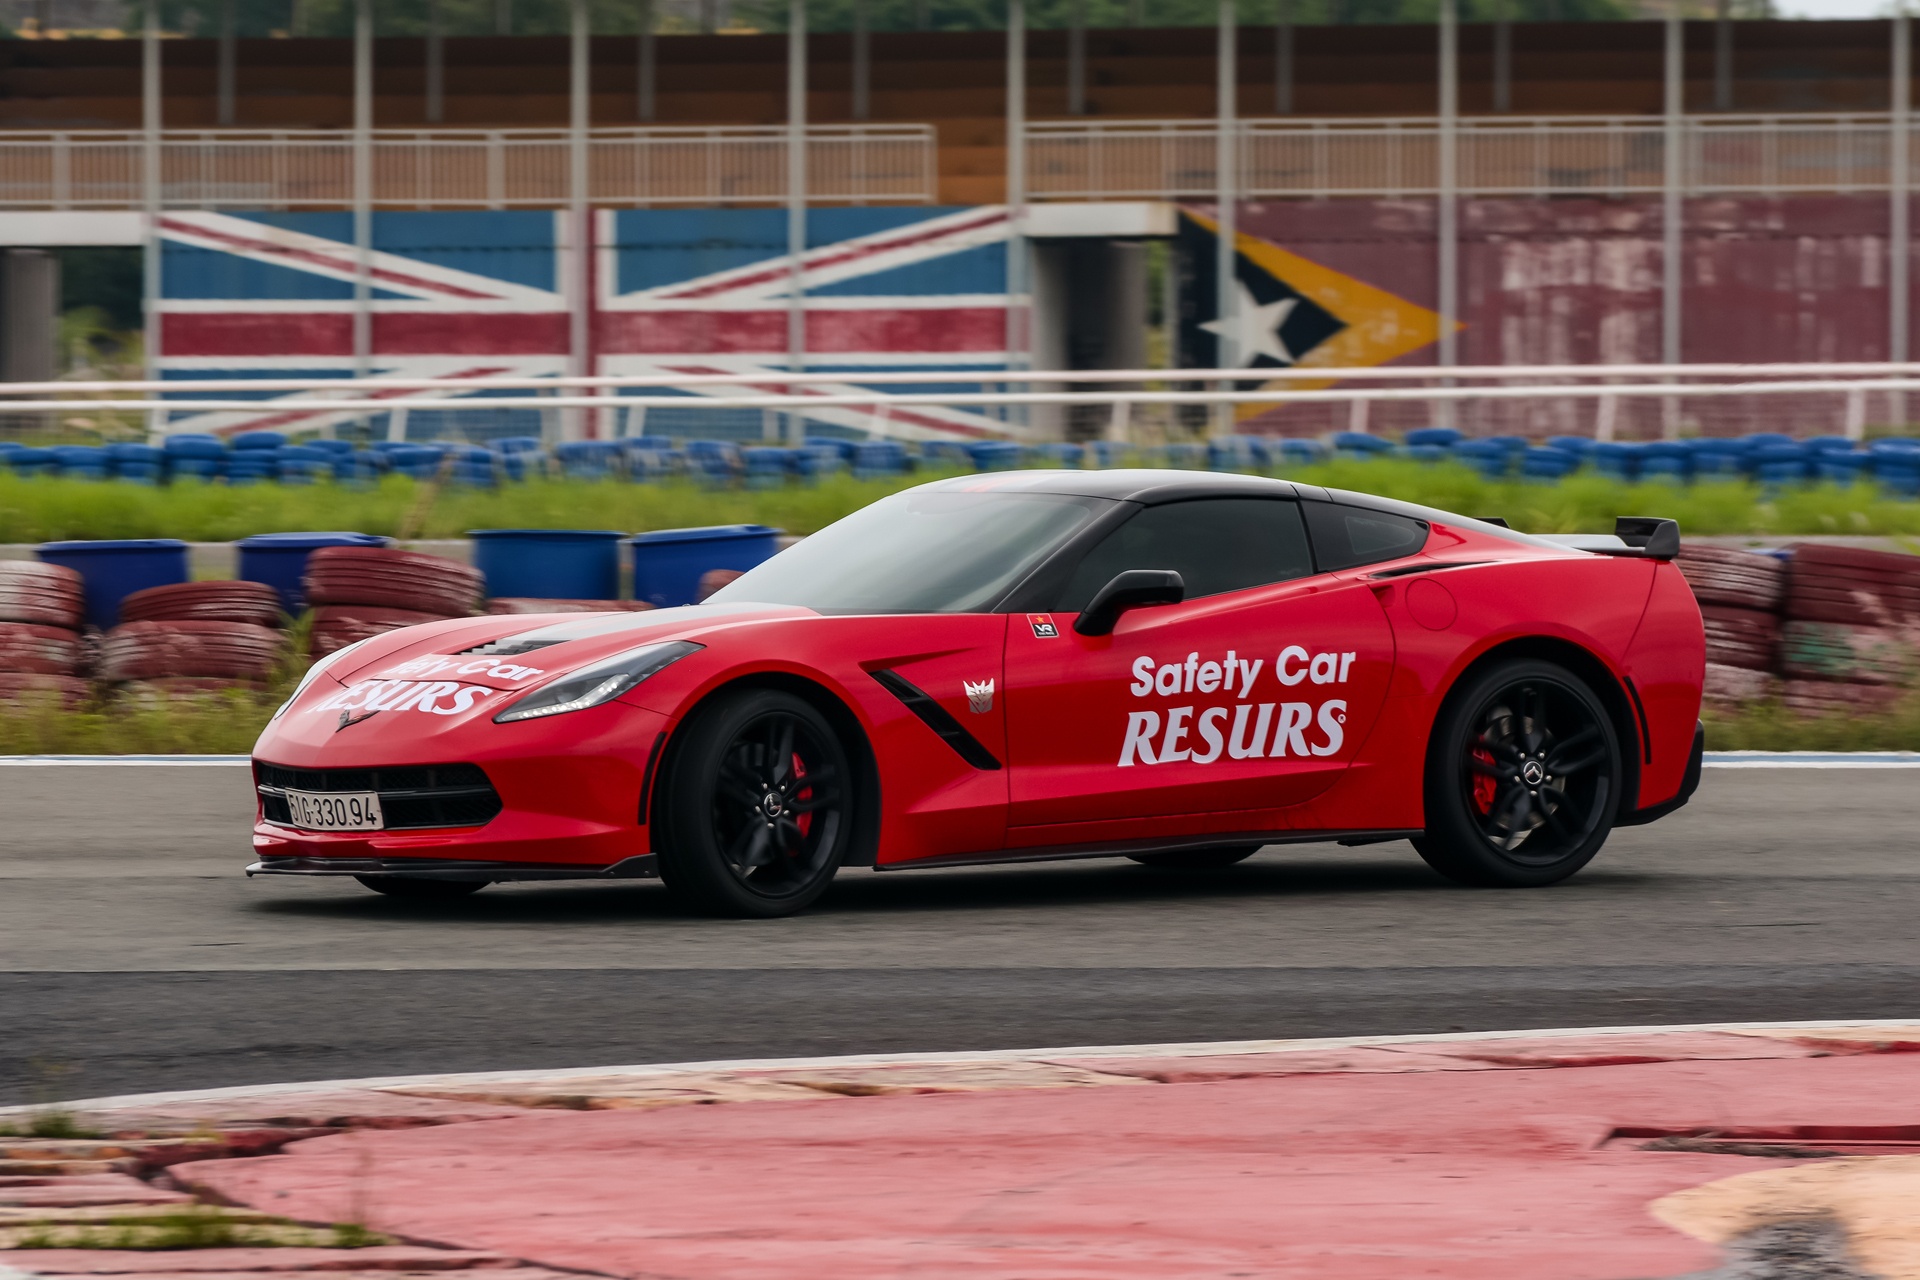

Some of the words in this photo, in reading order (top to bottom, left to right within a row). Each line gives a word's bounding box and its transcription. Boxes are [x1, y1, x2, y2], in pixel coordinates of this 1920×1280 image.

[383, 657, 462, 678] ety
[456, 658, 544, 681] Car
[1130, 651, 1263, 698] Safety
[1275, 645, 1356, 686] Car
[1117, 699, 1348, 767] RESURS
[288, 794, 377, 826] 51G-330.94
